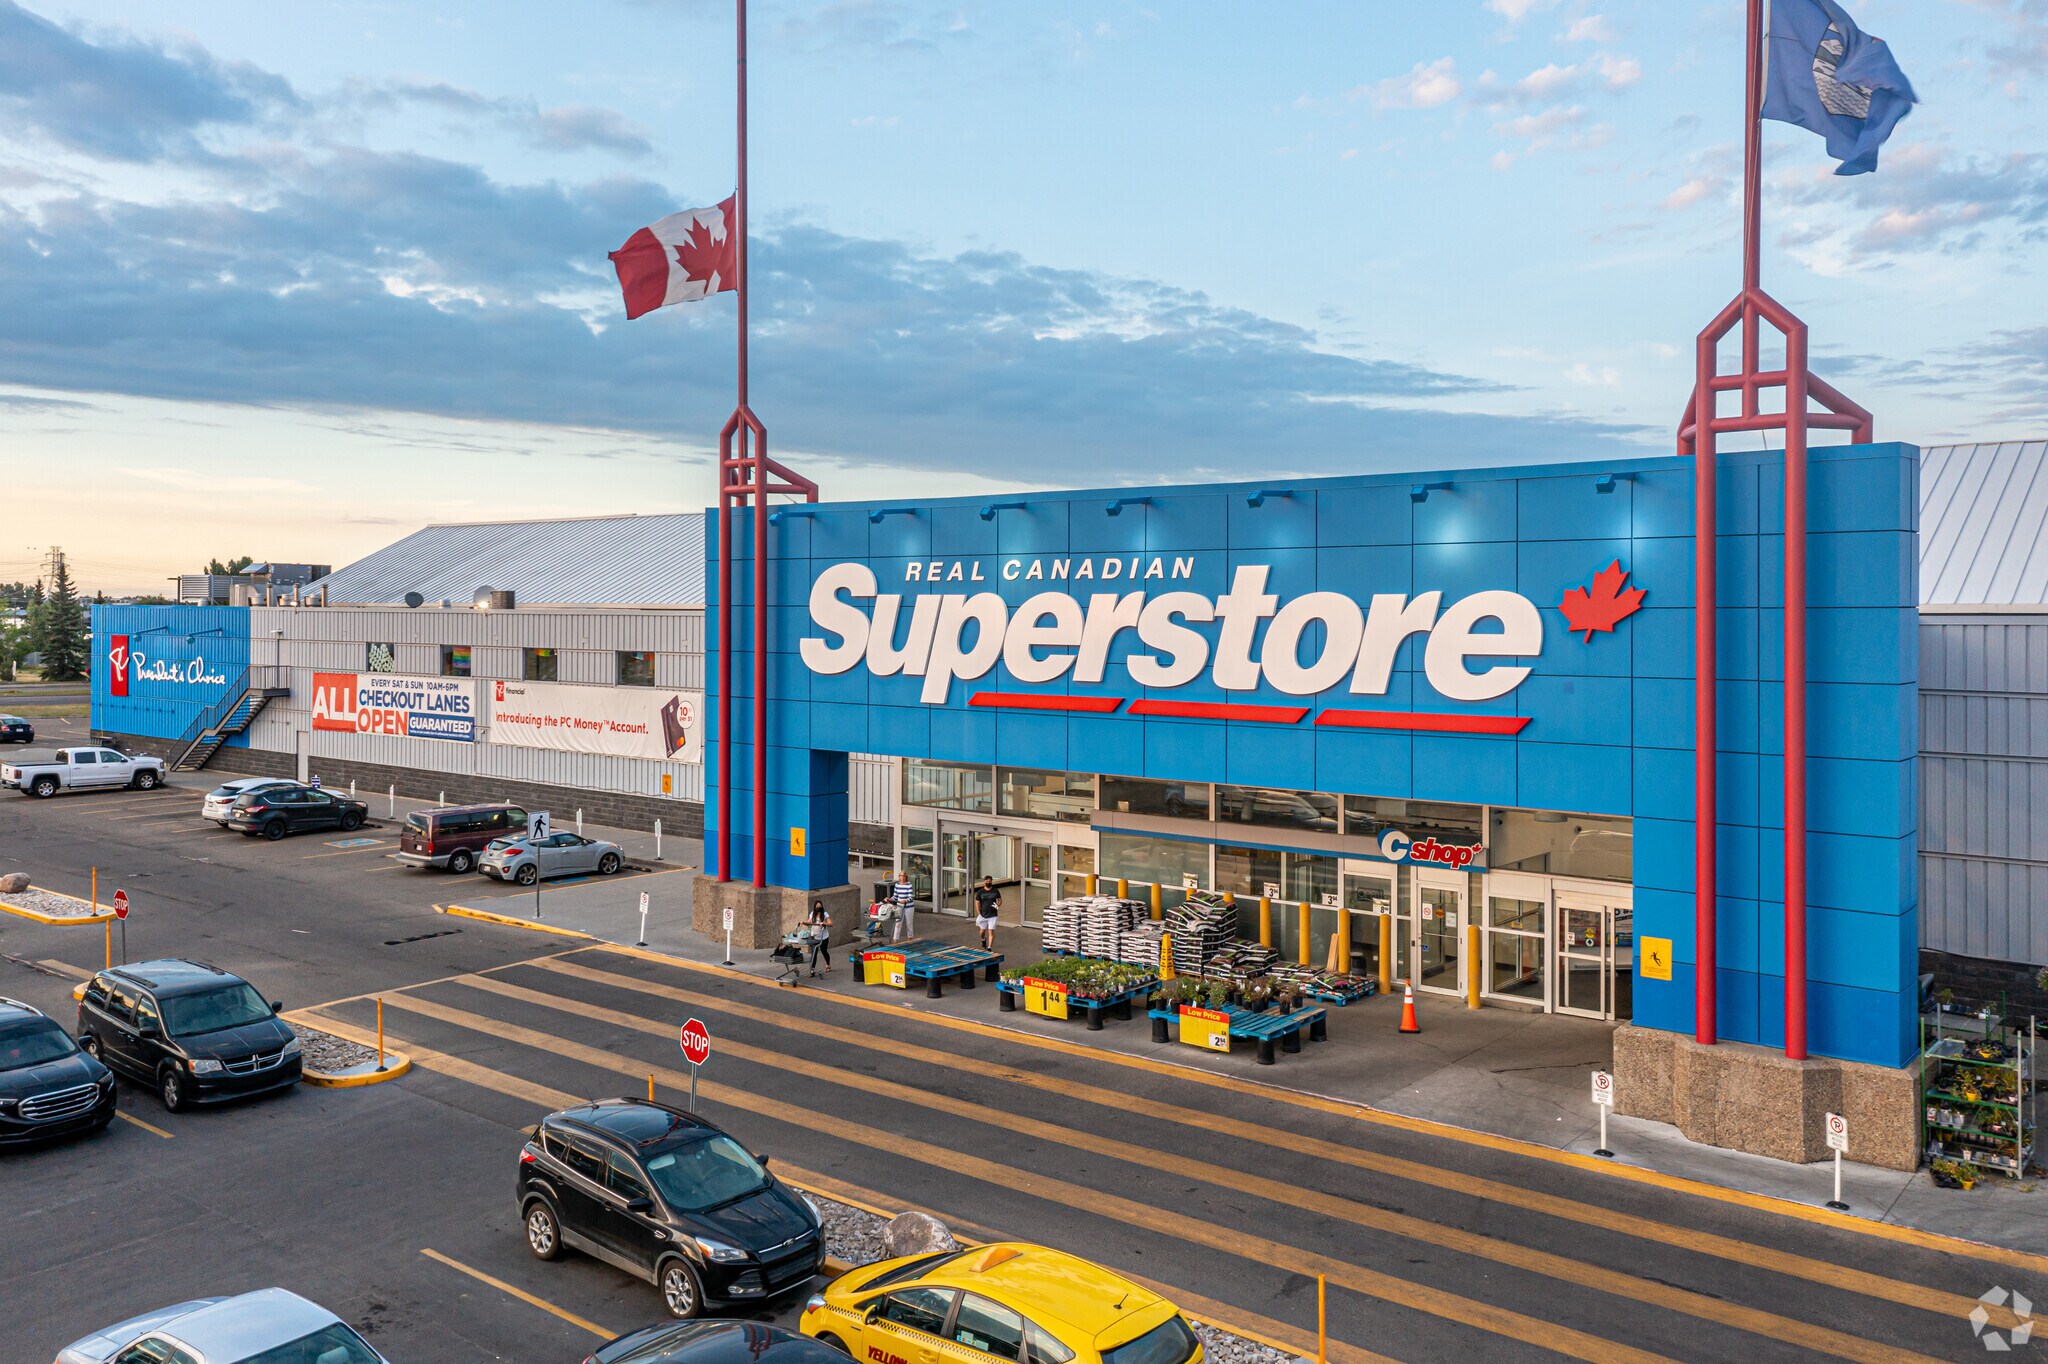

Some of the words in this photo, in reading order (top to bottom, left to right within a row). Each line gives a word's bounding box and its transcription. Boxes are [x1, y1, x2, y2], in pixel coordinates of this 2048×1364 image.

[905, 561, 985, 582] REAL
[1002, 556, 1195, 581] CANADIAN
[800, 562, 1543, 704] Superstore
[132, 652, 184, 682] President's
[187, 656, 226, 684] Choice
[371, 679, 390, 688] EVERY
[392, 680, 403, 688] SAT
[410, 681, 424, 690] SUN
[426, 682, 459, 692] 10AM-6PM
[505, 686, 526, 695] financial
[312, 686, 357, 722] ALL
[359, 689, 424, 710] CHECKOUT
[427, 694, 470, 713] LANES
[679, 706, 688, 716] 10
[358, 708, 408, 736] OPEN
[496, 712, 542, 729] Introducing
[544, 715, 557, 727] the
[560, 717, 571, 728] PC
[610, 720, 649, 734] Account.
[1382, 831, 1409, 861] C
[1410, 837, 1473, 869] shop
[115, 898, 127, 911] STOP
[1030, 979, 1043, 987] Low
[1044, 982, 1059, 991] Price
[1187, 1008, 1201, 1017] Low
[1203, 1011, 1220, 1021] Price
[682, 1029, 708, 1053] STOP
